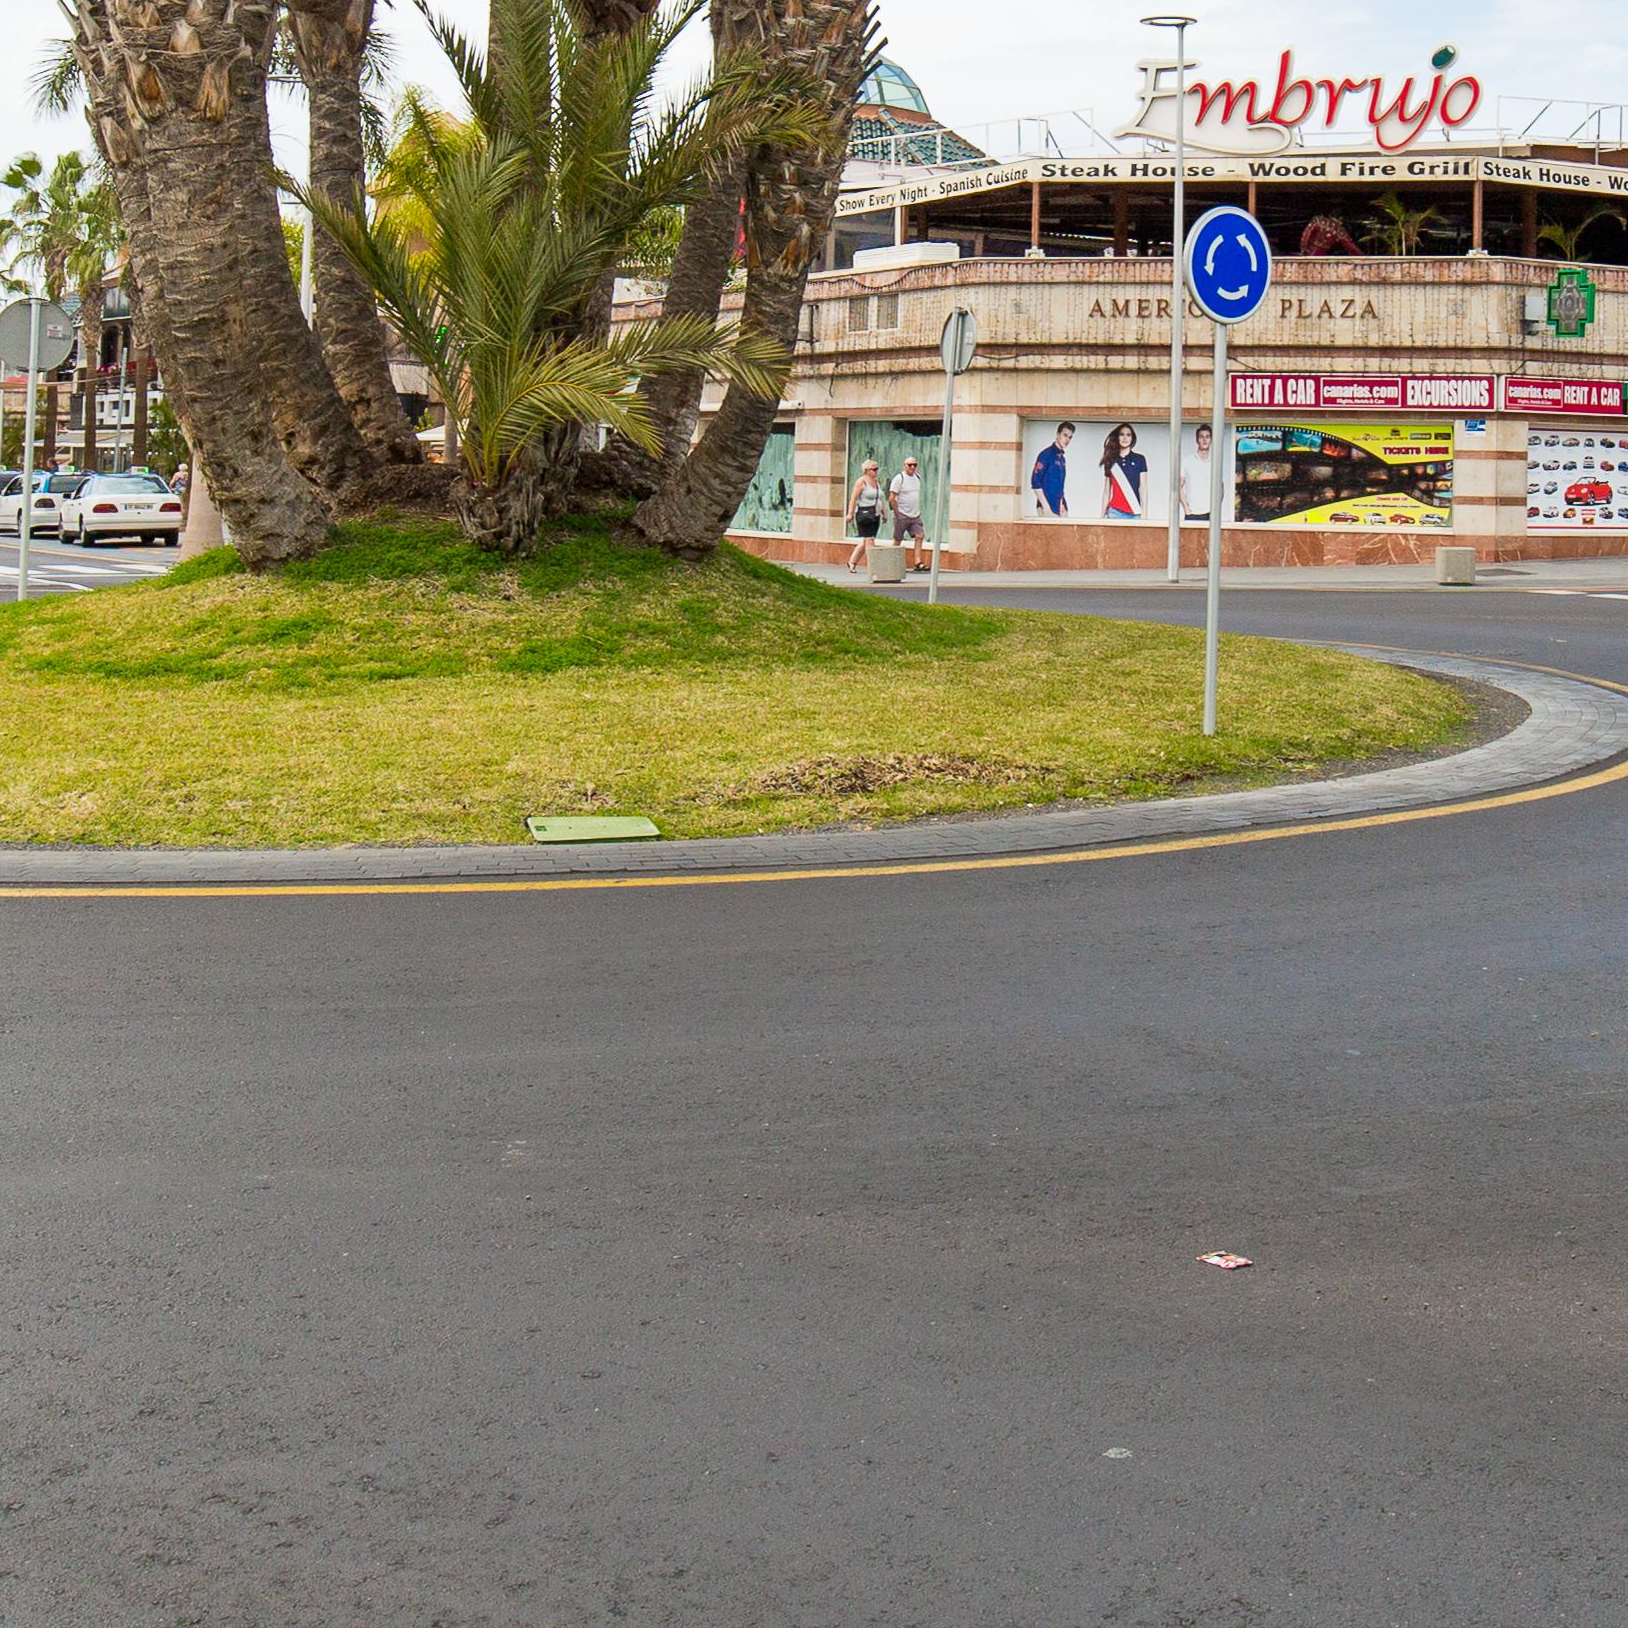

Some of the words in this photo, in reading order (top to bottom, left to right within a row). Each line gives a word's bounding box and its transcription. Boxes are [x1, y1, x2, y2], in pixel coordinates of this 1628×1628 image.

[1113, 44, 1482, 156] Embrujo
[1041, 163, 1118, 178] Steak
[1248, 162, 1327, 177] Wood
[1339, 162, 1396, 177] Fire
[1407, 161, 1470, 176] Grill
[1484, 161, 1532, 181] Steak
[1538, 168, 1590, 187] House
[839, 197, 865, 212] Show
[869, 192, 895, 207] Every
[900, 185, 928, 203] Night
[939, 177, 983, 196] Spanish
[986, 166, 1029, 186] Cuisine
[1280, 298, 1380, 319] PLAZA
[1236, 378, 1271, 404] RENT
[1274, 380, 1282, 405] A
[1286, 379, 1316, 405] CAR
[1323, 384, 1399, 399] canarias.com
[1406, 380, 1489, 406] EXCURSIONS
[1564, 385, 1589, 405] RENT
[1590, 387, 1598, 405] A
[1600, 388, 1620, 407] CAR
